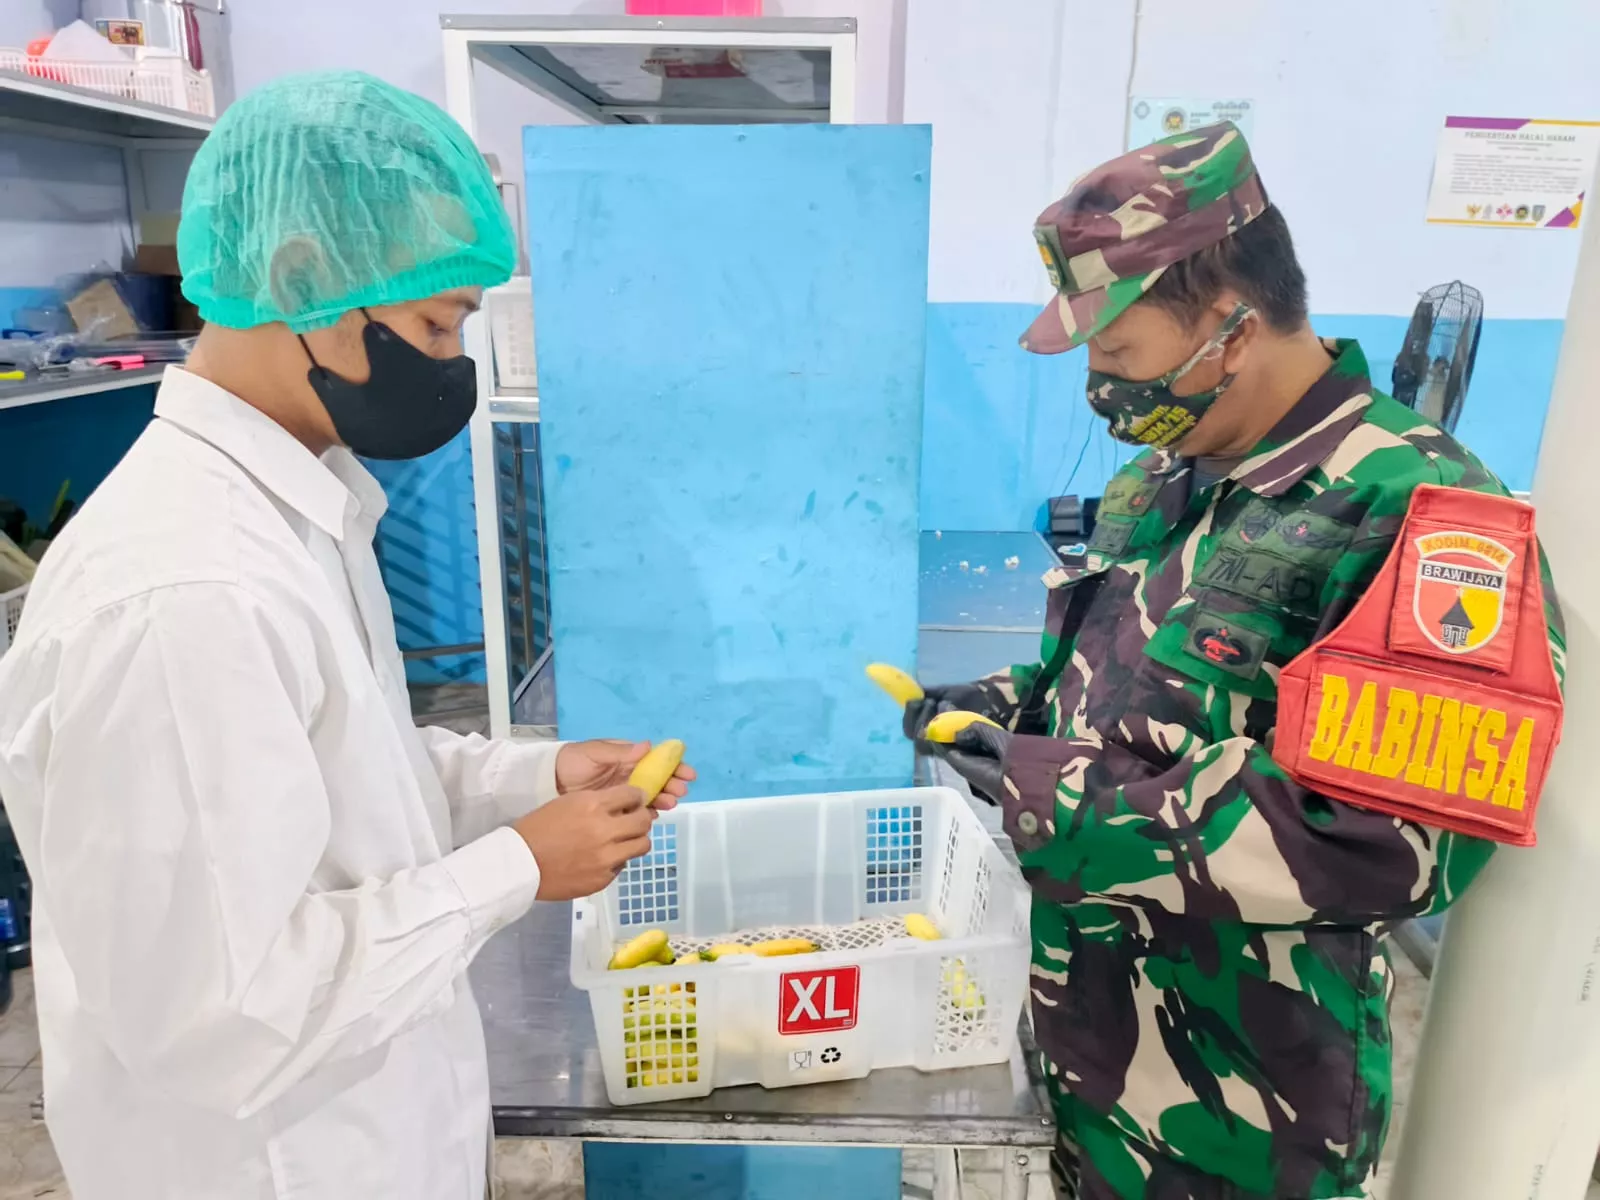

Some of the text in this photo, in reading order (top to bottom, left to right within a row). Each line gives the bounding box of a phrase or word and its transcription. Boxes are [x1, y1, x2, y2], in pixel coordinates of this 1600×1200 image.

[1423, 564, 1499, 588] BRAWIJAYA
[1308, 673, 1536, 812] BABINSA
[786, 975, 850, 1023] XL
